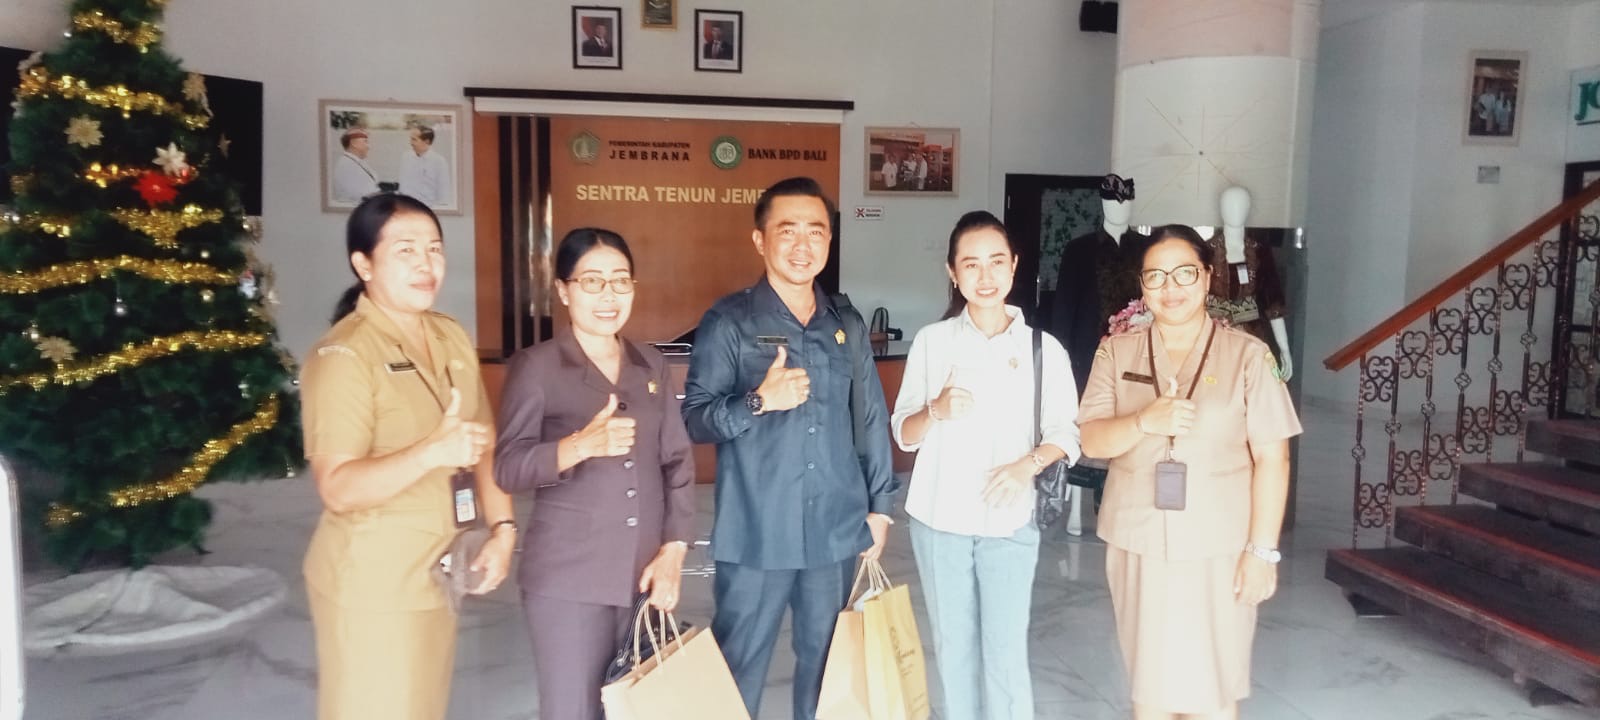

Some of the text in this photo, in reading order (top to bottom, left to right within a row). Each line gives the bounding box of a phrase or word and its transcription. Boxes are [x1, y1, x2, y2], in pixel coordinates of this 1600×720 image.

[652, 141, 690, 149] KABUPATEN
[609, 150, 690, 161] JEMBRANA
[748, 148, 827, 161] BANK BPD BALI
[576, 184, 649, 202] SENTRA
[655, 186, 715, 203] TENUN
